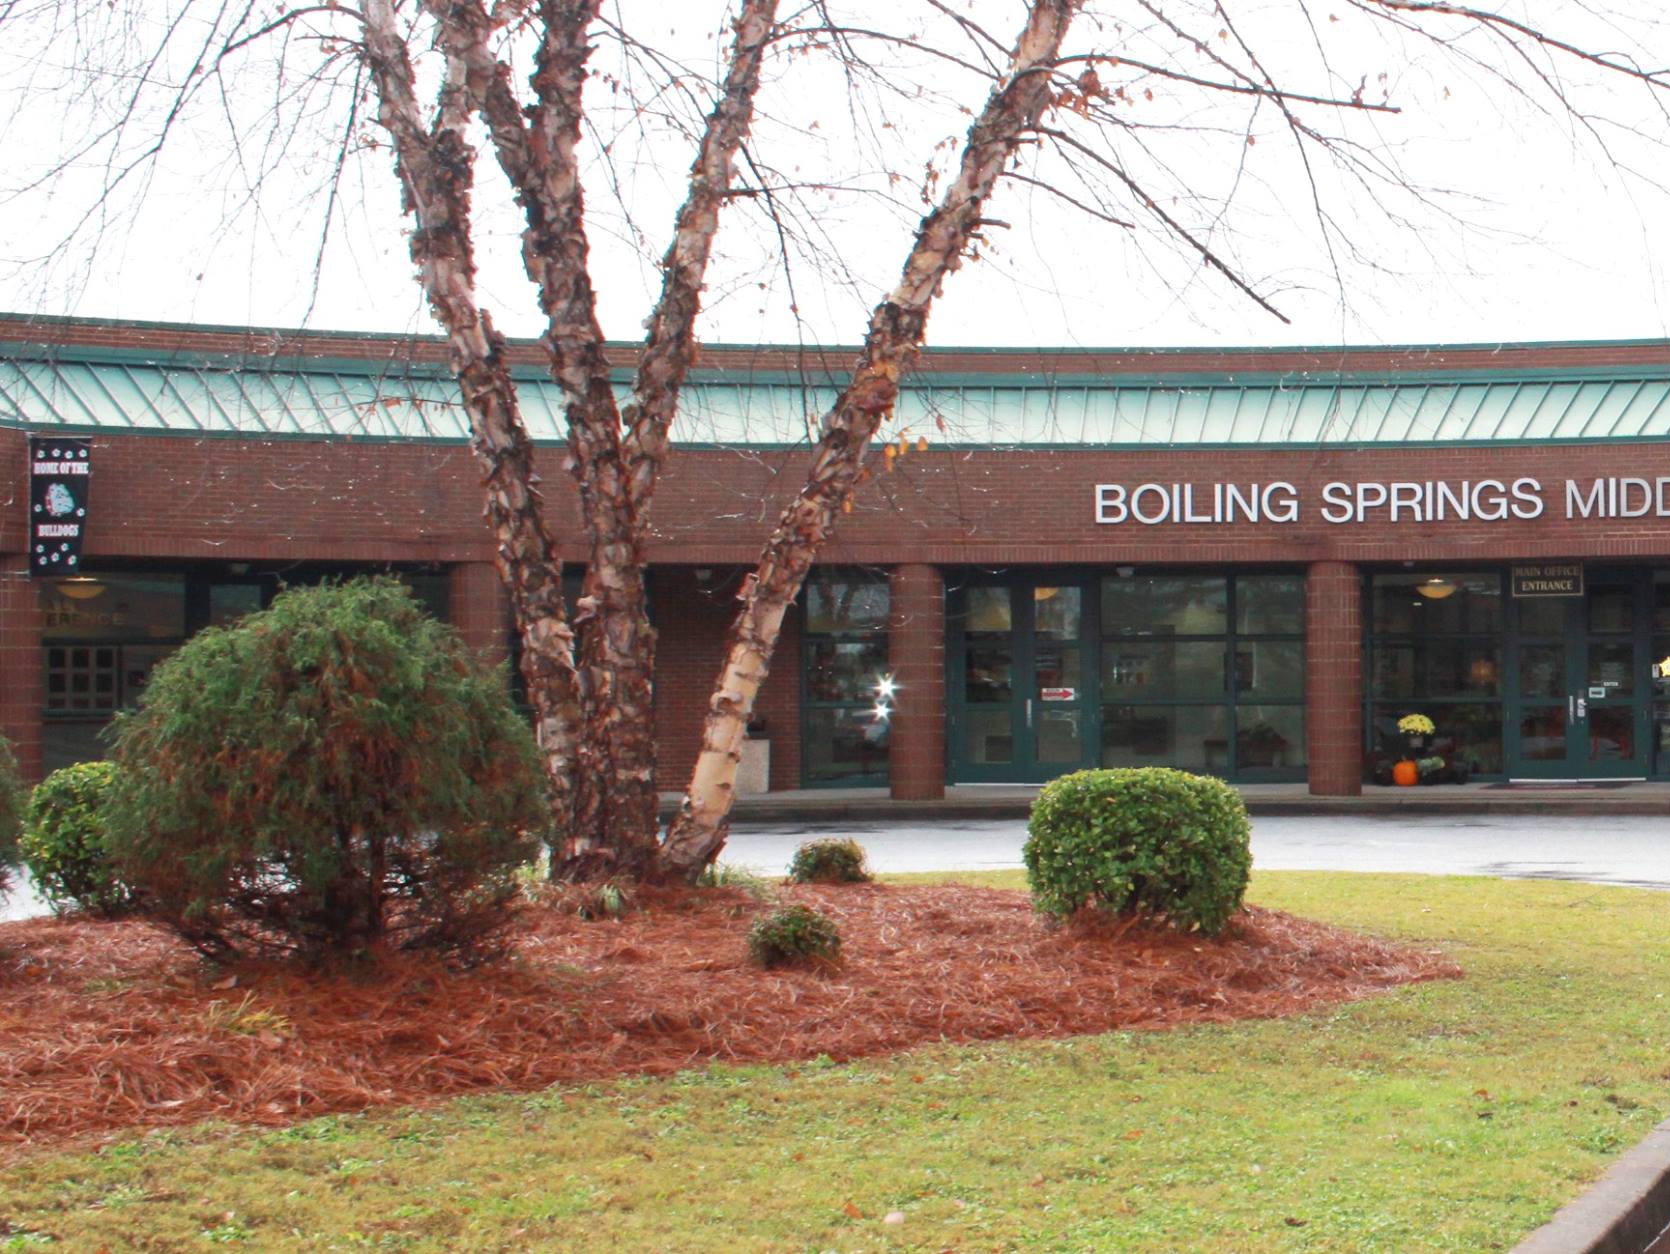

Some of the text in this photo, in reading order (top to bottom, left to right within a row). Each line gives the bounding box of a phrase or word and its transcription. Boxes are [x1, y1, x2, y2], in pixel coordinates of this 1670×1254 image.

[33, 462, 89, 474] HOME OF THE
[1094, 481, 1298, 524] BOILING
[1320, 476, 1544, 523] SPRINGS
[37, 523, 79, 537] BULLDOGS
[1515, 566, 1580, 577] MAIN OFFICE
[1521, 580, 1574, 592] ENTRANCE
